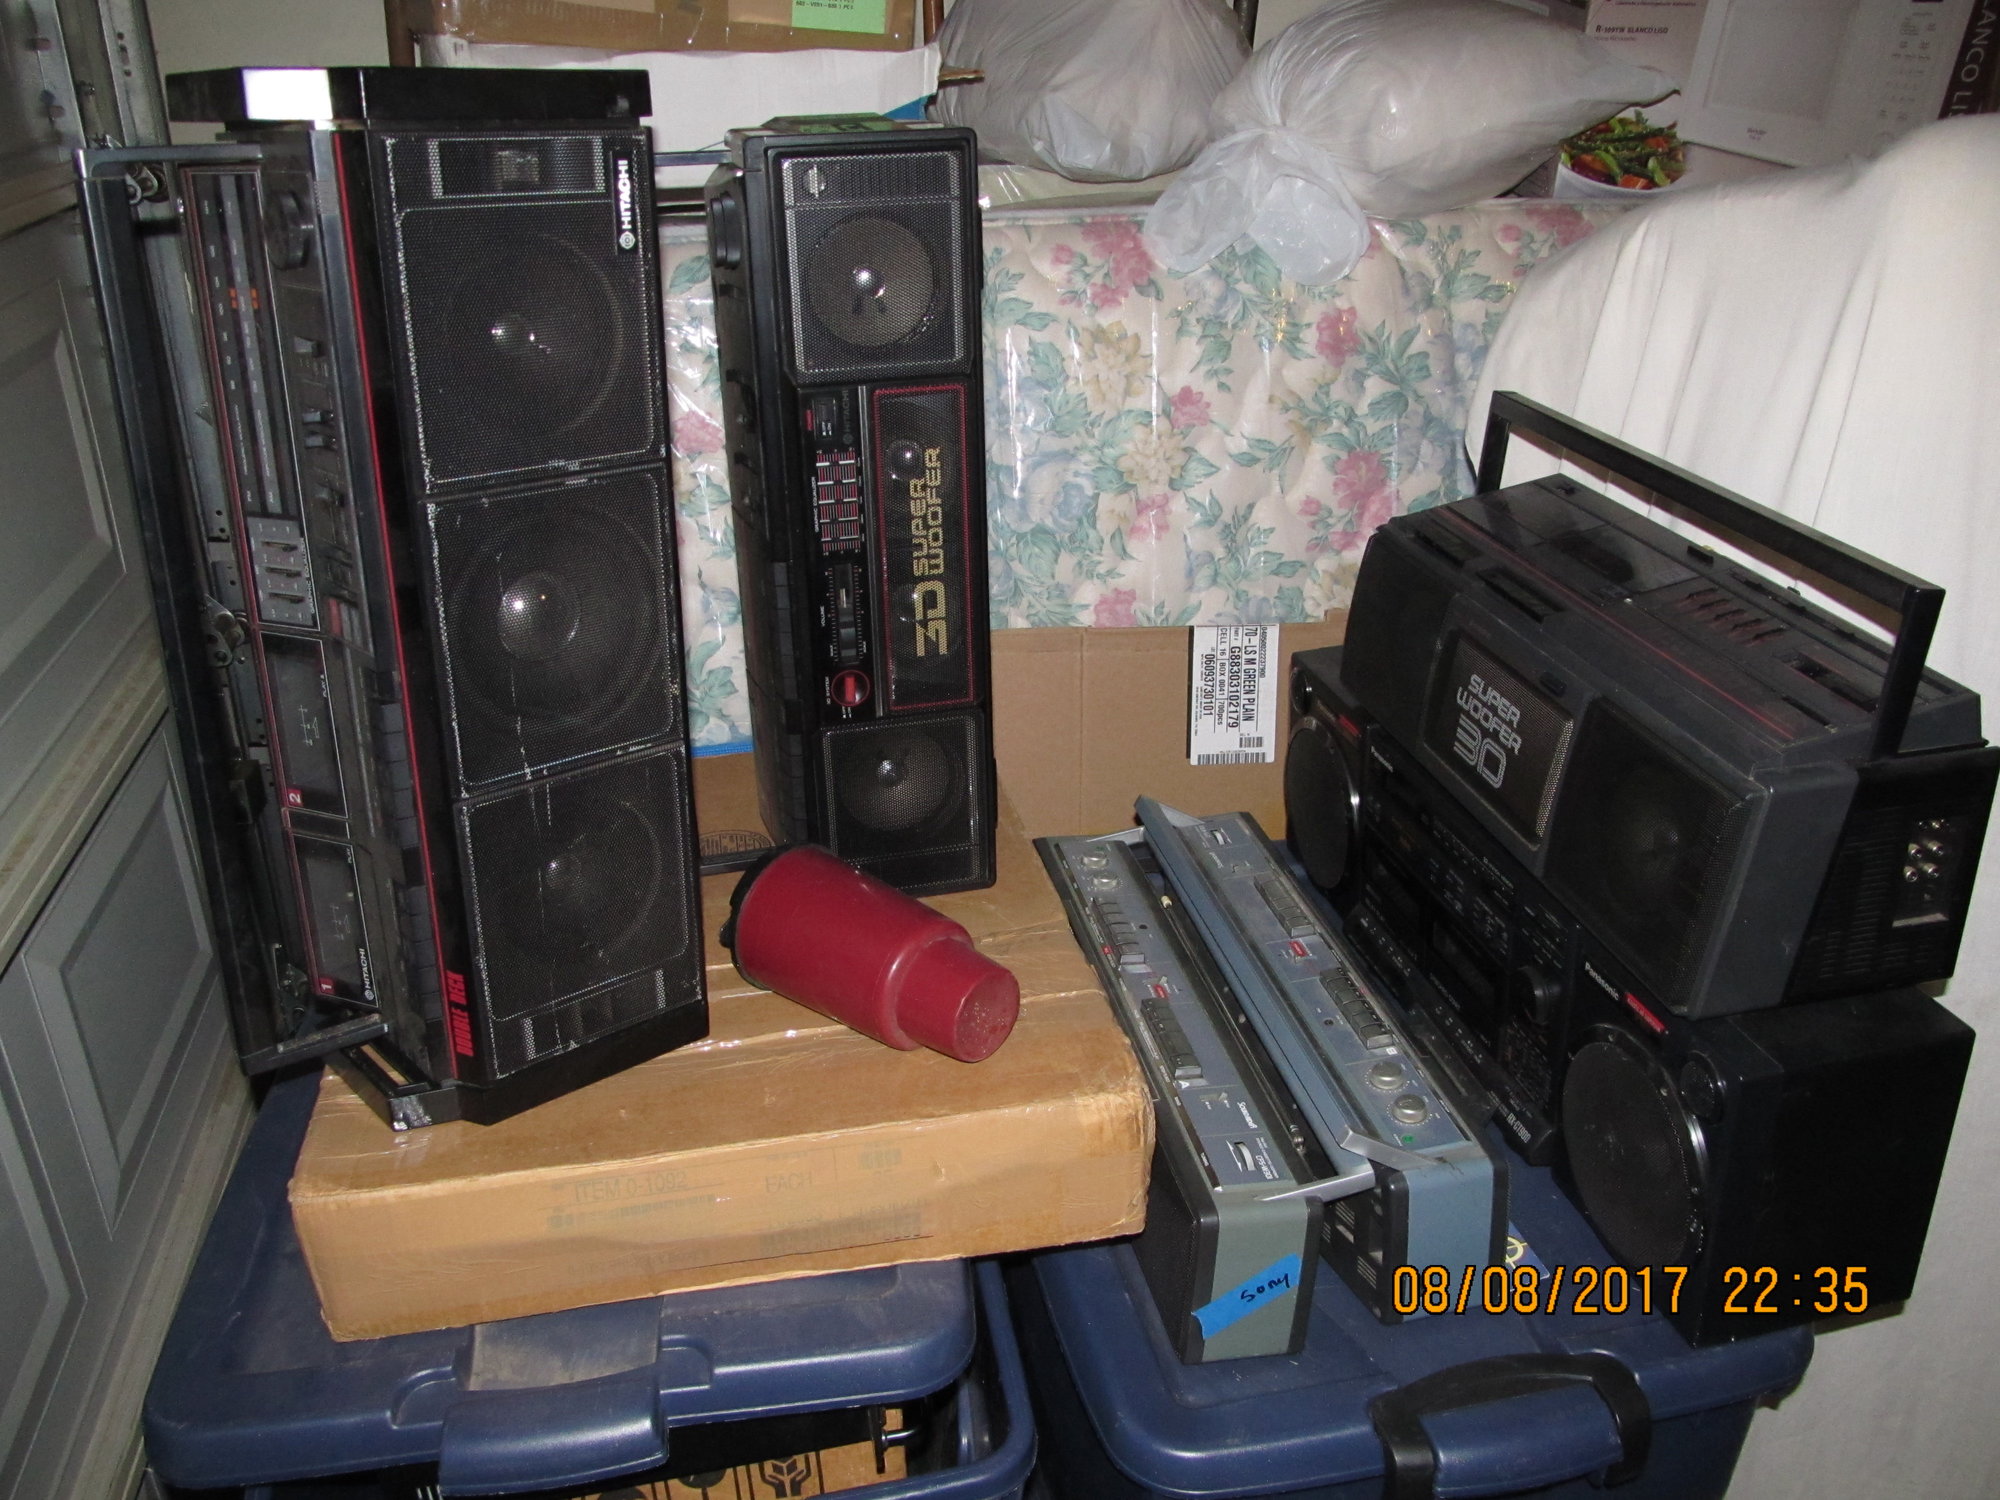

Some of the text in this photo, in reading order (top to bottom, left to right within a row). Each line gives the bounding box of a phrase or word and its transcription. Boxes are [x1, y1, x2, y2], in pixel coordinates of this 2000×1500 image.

[1961, 0, 1997, 82] ANCO
[619, 159, 629, 230] HITACHI
[842, 389, 851, 433] HITACHI
[910, 478, 929, 576] SUPER
[924, 445, 945, 575] WOOFER
[913, 580, 949, 657] 3D
[1219, 627, 1228, 656] CELL 16
[1243, 658, 1257, 666] M
[1203, 653, 1215, 716] 06093730101
[1218, 662, 1227, 696] BOX 0041
[1228, 646, 1241, 729] G88303102179
[1243, 668, 1257, 695] GREEN
[1216, 700, 1226, 726] 700pcs
[1241, 698, 1255, 722] PLAIN
[1456, 685, 1522, 756] WOOFER
[1467, 673, 1521, 729] SUPER
[1453, 713, 1507, 789] 3D
[289, 792, 302, 803] 2
[320, 981, 332, 991] 1
[358, 947, 371, 990] HITACHI
[1584, 961, 1620, 1002] Panasonic
[448, 971, 474, 1057] DOUBLE DECK
[1386, 1047, 1397, 1055] B
[1178, 1080, 1189, 1089] A
[1506, 1112, 1532, 1144] RX-CT900
[574, 1171, 812, 1202] ITEM 0-1092 EACH
